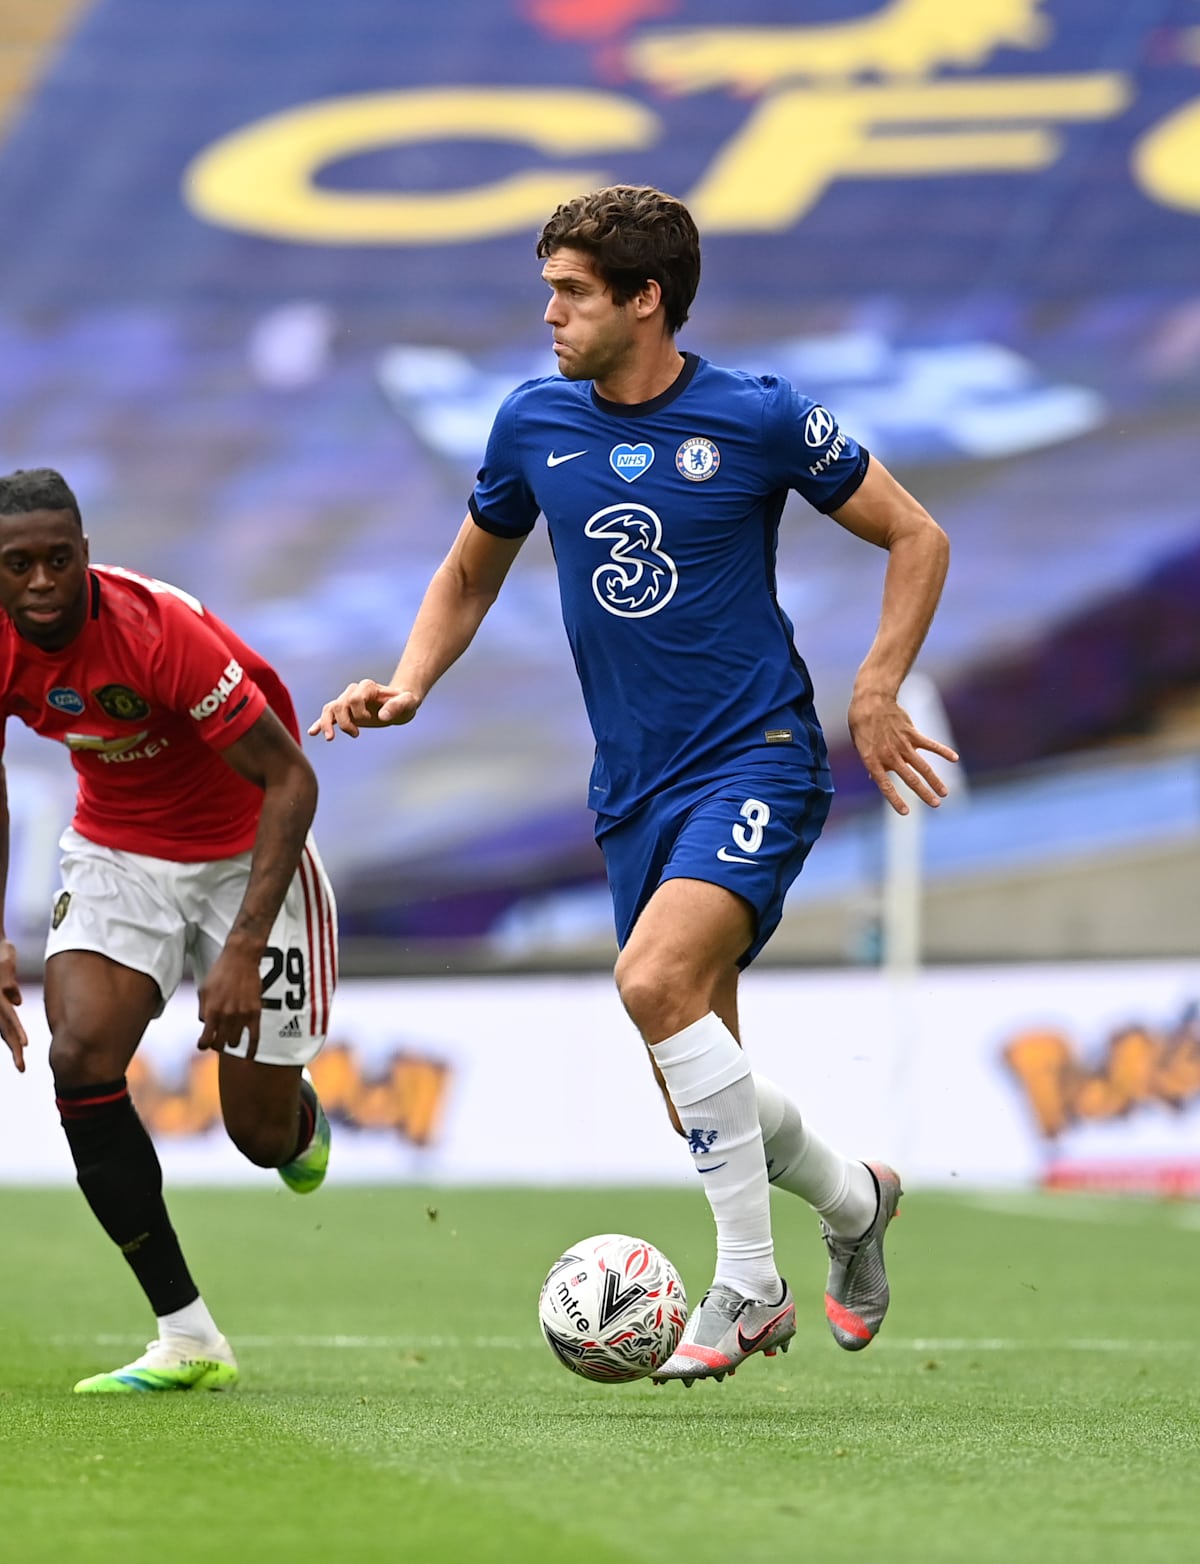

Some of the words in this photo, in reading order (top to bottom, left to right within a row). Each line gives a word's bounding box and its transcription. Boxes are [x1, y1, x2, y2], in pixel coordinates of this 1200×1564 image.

[182, 73, 1200, 246] CF
[618, 455, 645, 465] NHS
[731, 798, 771, 853] 3
[260, 946, 307, 1010] 29
[555, 1281, 590, 1333] mitre
